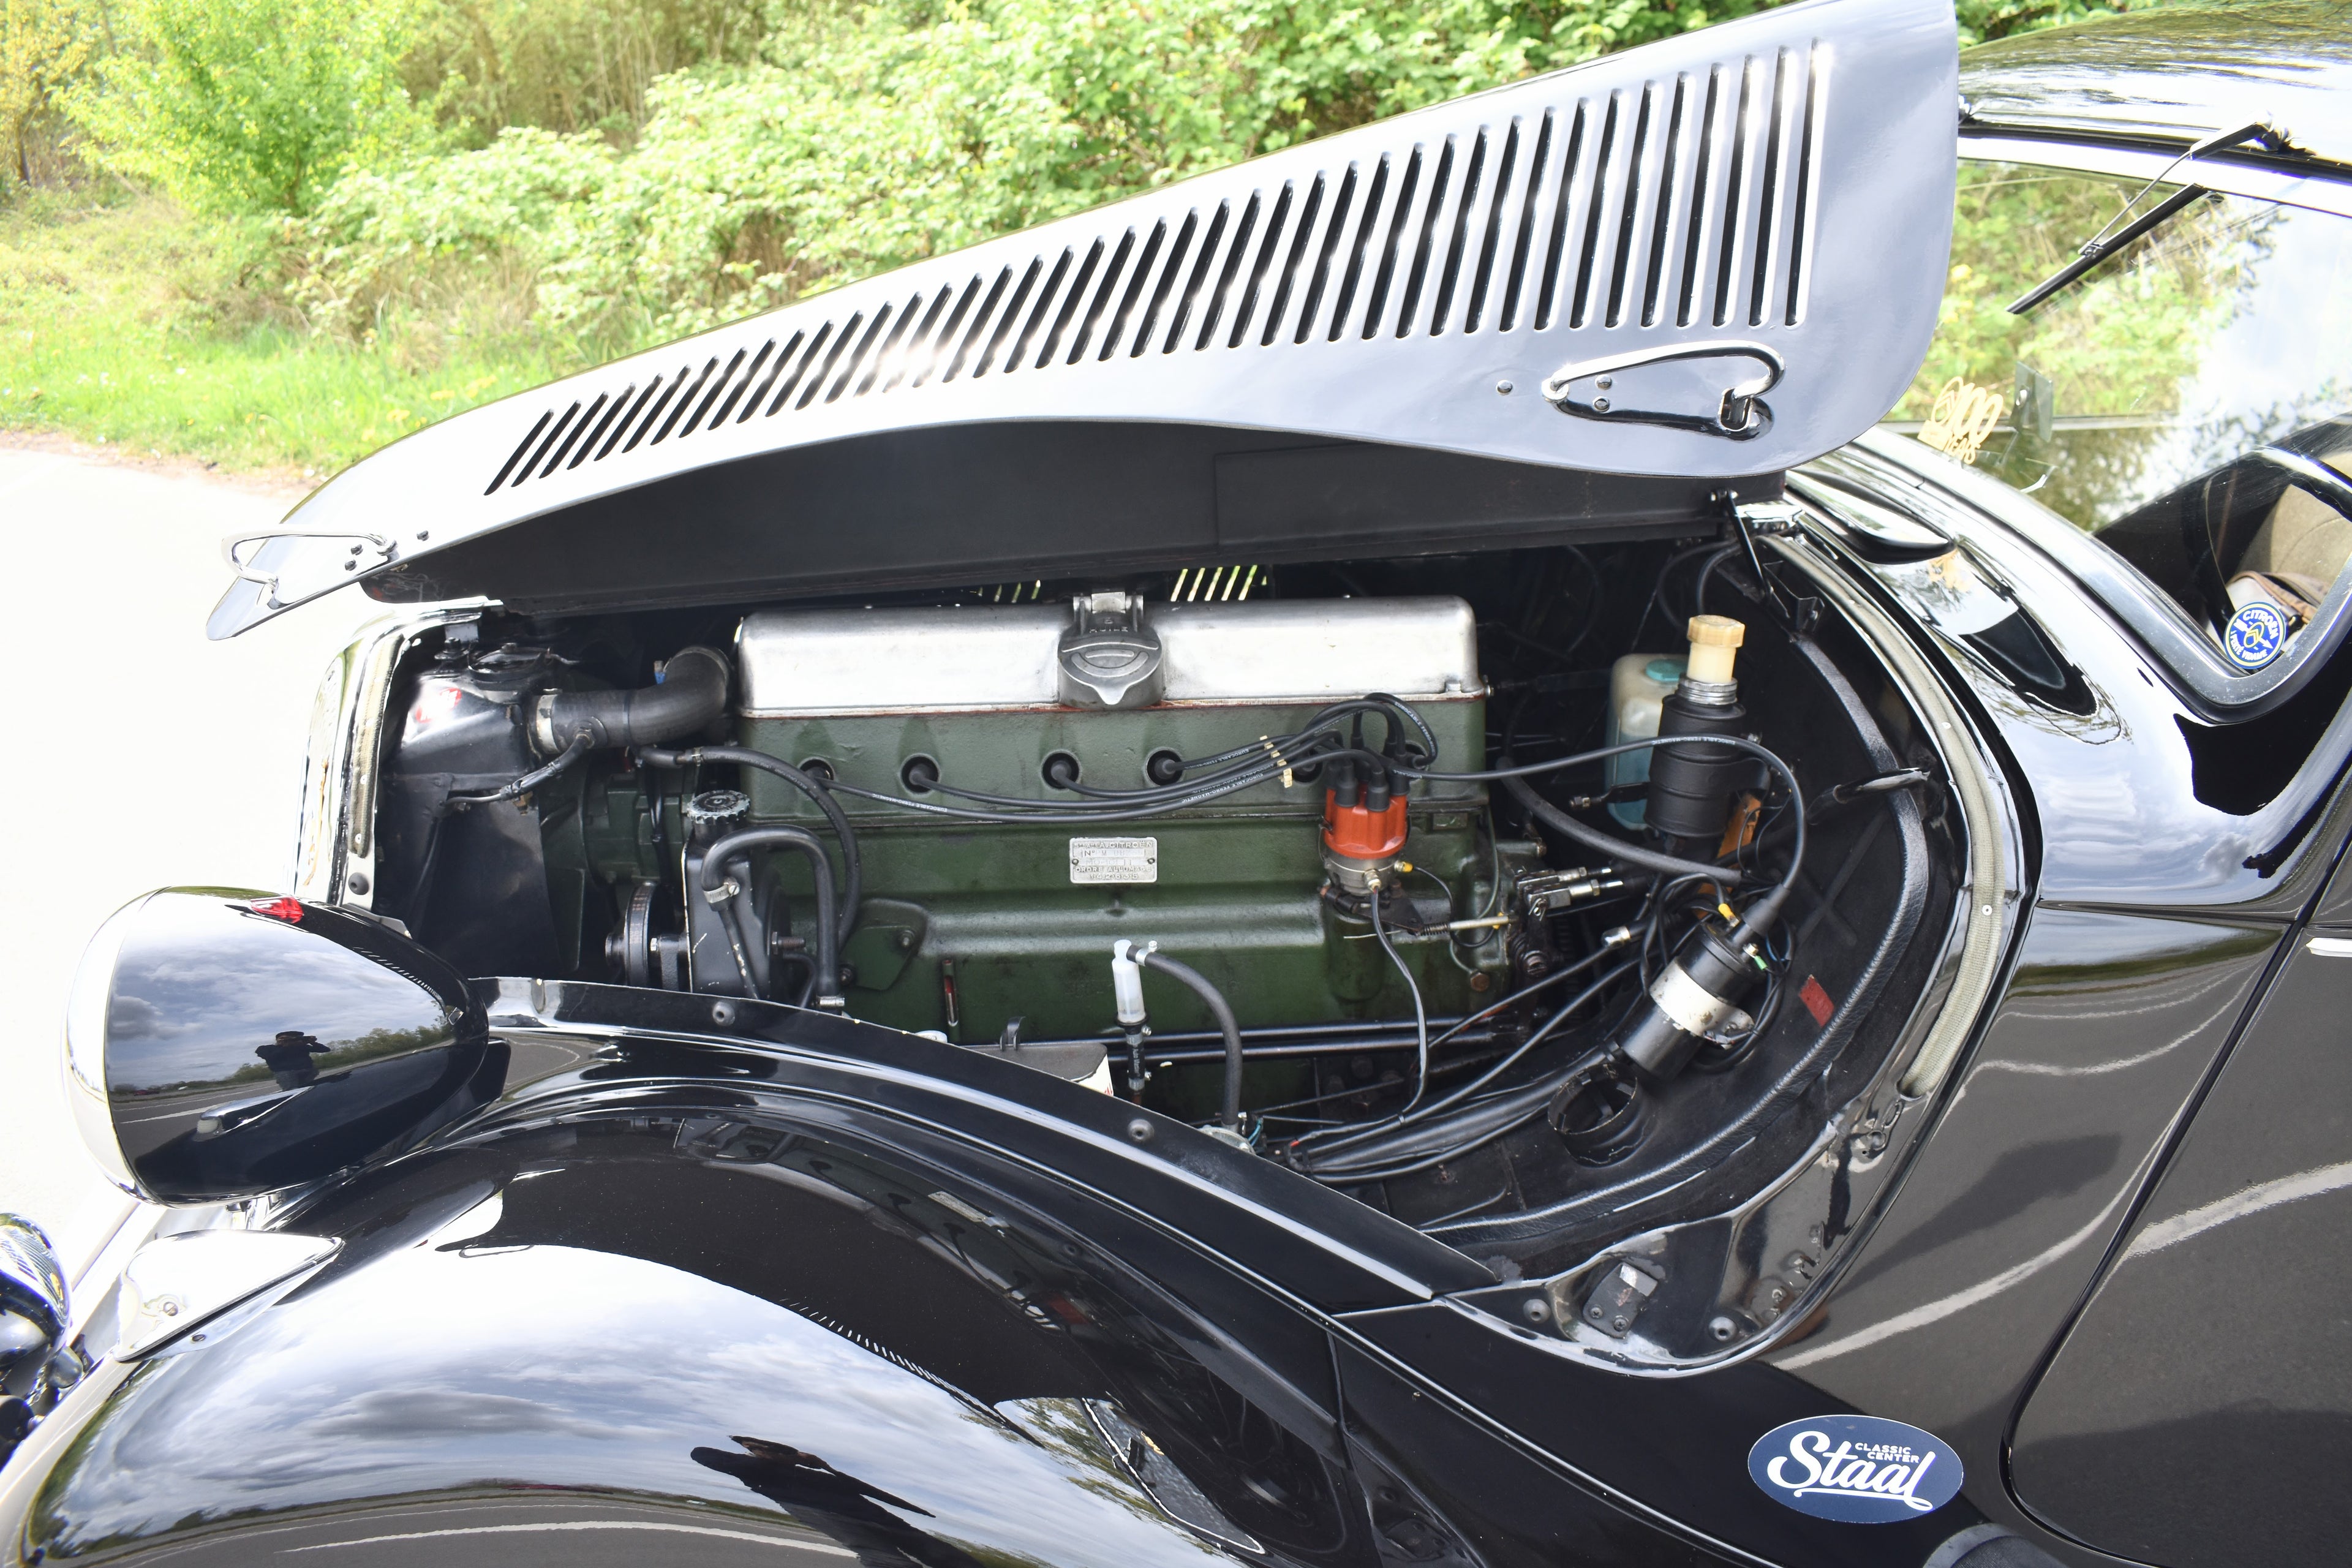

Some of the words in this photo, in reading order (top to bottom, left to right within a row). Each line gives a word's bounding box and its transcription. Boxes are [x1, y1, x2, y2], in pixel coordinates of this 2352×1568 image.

[1948, 382, 2003, 445] 100
[1394, 701, 1422, 727] EUROCABLE
[1216, 748, 1250, 763] EUROCABLE
[1231, 772, 1264, 788] EUROCABLE
[1181, 785, 1231, 804] FERRO-MAGNETIC
[1854, 1442, 1912, 1455] CLASSIC
[1866, 1452, 1920, 1464] CENTER
[1766, 1429, 1937, 1512] Staal
